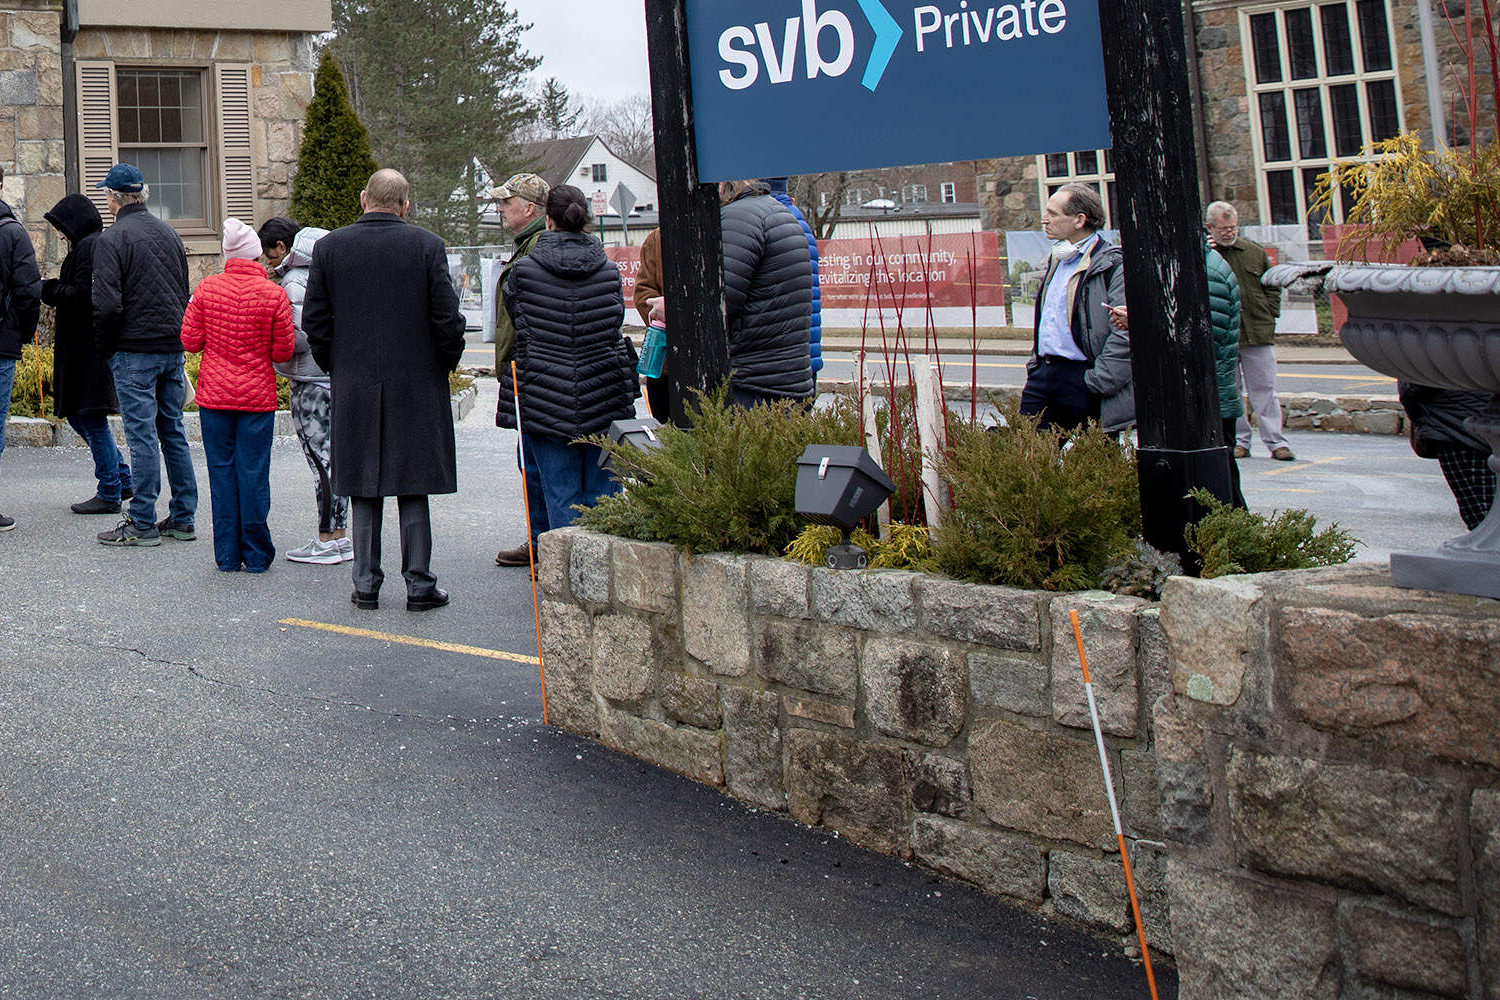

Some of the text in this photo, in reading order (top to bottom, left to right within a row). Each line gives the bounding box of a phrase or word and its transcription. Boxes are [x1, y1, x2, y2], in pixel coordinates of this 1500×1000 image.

[818, 252, 851, 270] esting
[852, 252, 863, 266] in
[819, 270, 870, 288] evitalizing
